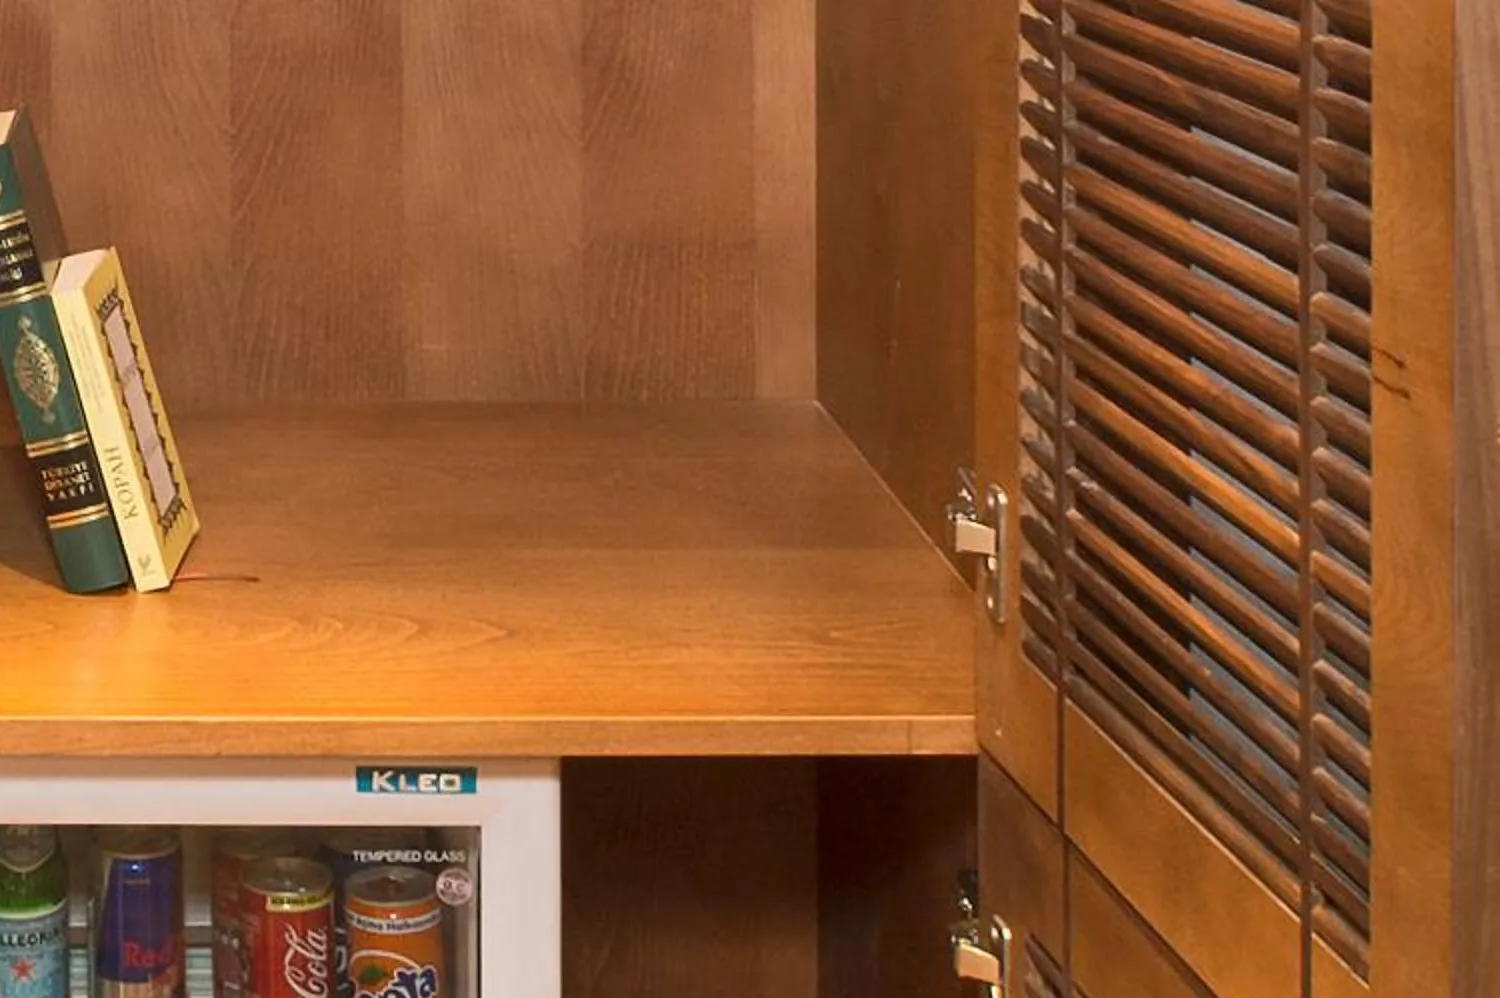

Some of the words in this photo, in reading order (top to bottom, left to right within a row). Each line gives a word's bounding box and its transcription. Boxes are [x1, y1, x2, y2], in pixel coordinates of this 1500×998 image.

[371, 770, 461, 793] KLEO
[353, 850, 421, 863] TEMPERED
[423, 850, 467, 863] GLASS
